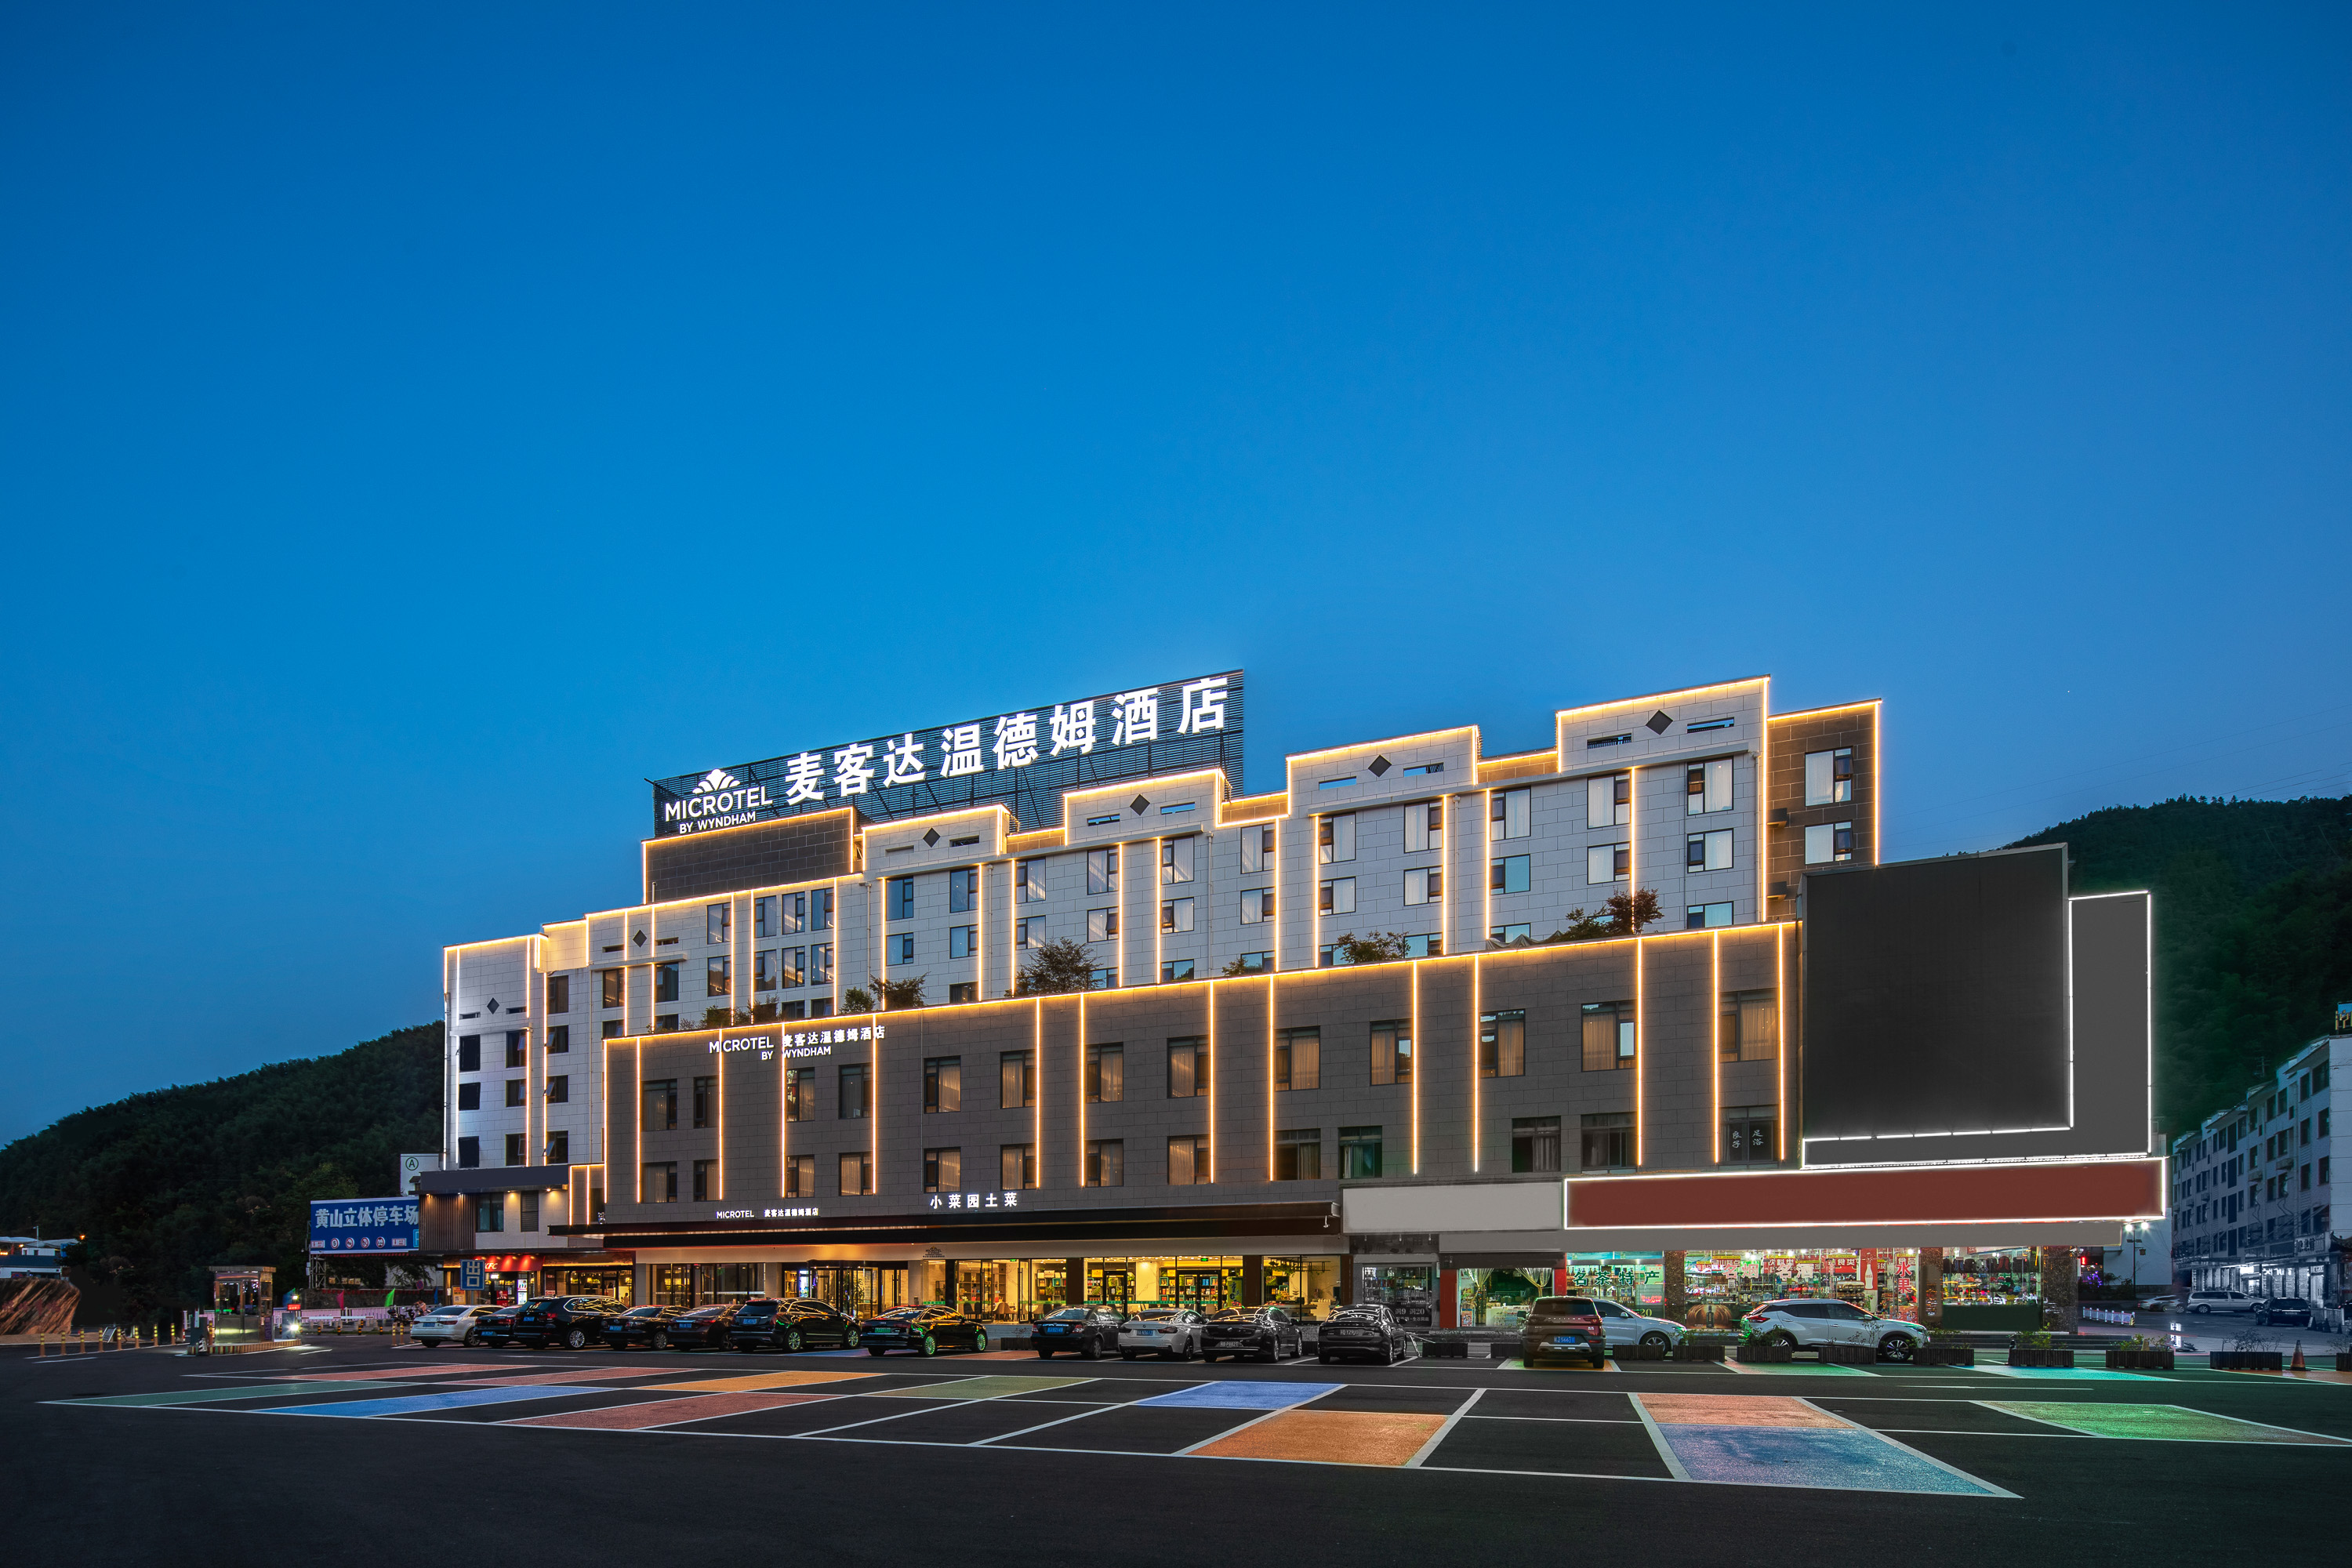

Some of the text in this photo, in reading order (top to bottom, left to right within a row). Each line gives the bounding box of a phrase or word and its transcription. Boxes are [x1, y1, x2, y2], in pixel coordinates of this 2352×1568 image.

[785, 676, 1229, 806] 麦客达温德姆酒店
[665, 786, 773, 822] MICROTEL
[679, 811, 757, 834] BY WYNDHAM
[782, 1025, 885, 1047] 麦客达温德姆酒店
[761, 1046, 832, 1060] BY WYNDHAM
[929, 1192, 1018, 1209] 小菜园土菜
[315, 1205, 419, 1229] 黄山立体停车场
[716, 1207, 819, 1218] MICROTEL 麦客达温德姆酒店
[466, 1261, 481, 1287] 出口
[1573, 1270, 1661, 1287] 名茶特产
[1722, 1263, 1760, 1279] 名烟
[1776, 1262, 1814, 1282] 名酒
[1895, 1261, 1912, 1294] 水果
